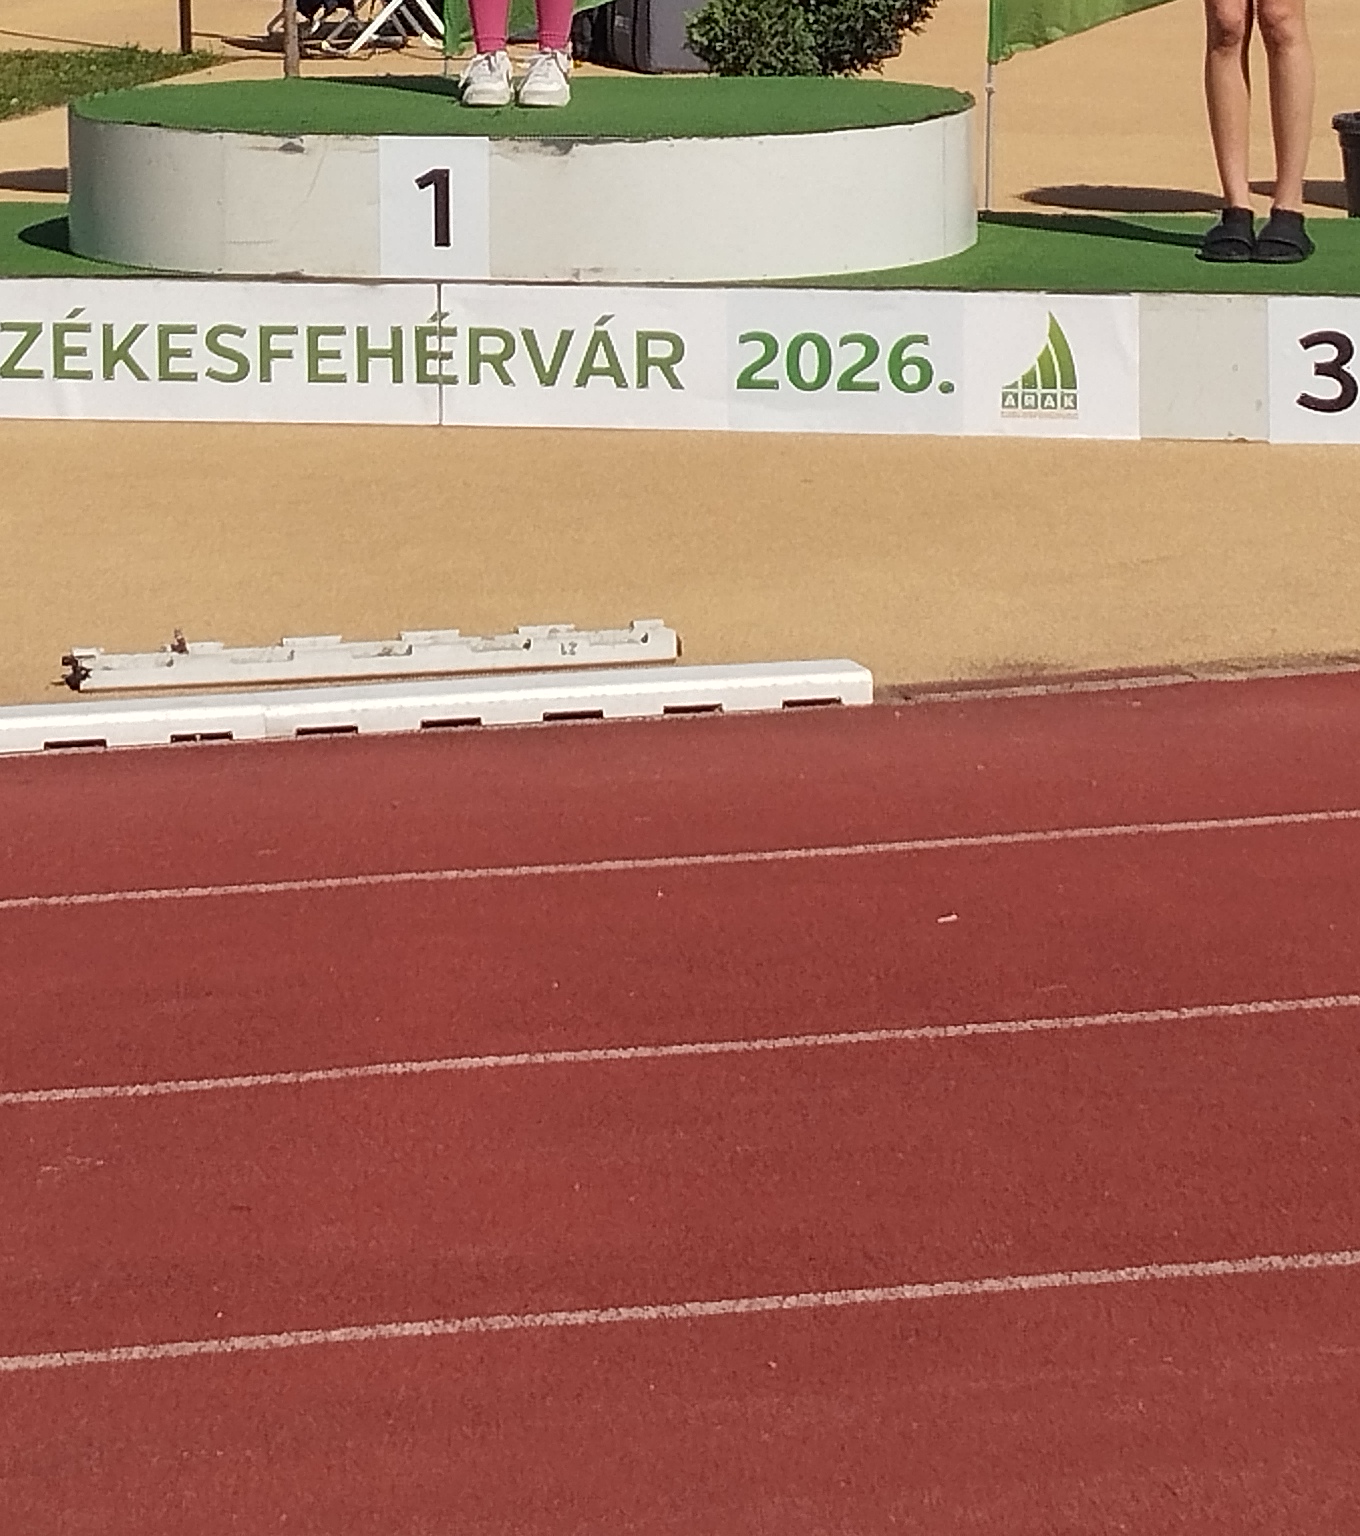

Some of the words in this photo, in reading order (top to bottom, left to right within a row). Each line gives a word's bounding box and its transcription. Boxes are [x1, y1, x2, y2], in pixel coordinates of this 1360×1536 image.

[414, 168, 452, 248] 1
[736, 330, 955, 395] 2026.
[1295, 330, 1359, 413] 3
[1003, 393, 1075, 408] ARAK
